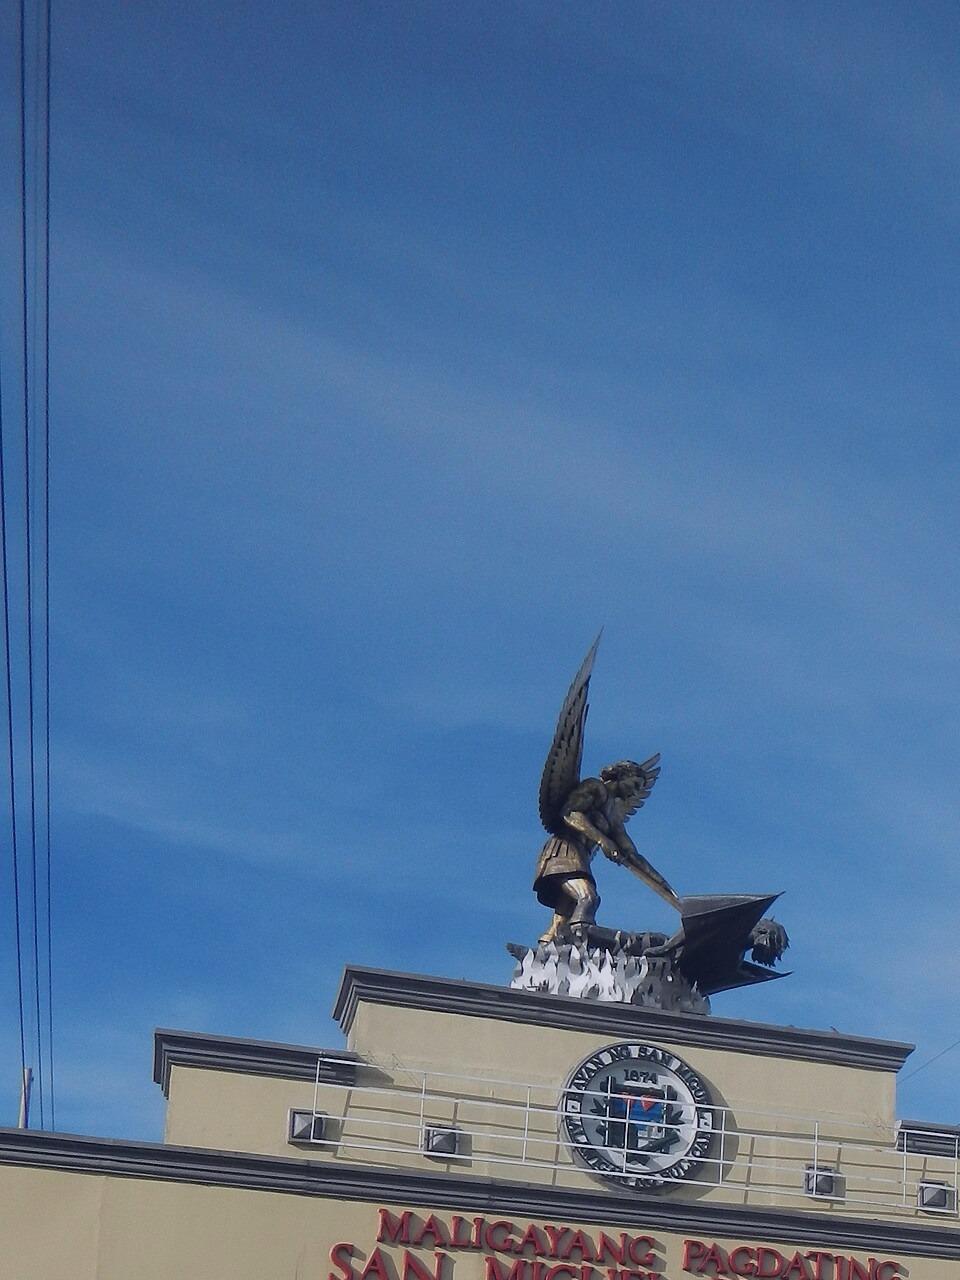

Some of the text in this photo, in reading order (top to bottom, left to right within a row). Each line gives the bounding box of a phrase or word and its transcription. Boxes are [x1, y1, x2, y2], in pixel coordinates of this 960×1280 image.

[639, 1045, 674, 1068] SAN
[623, 1068, 658, 1085] 1874
[376, 1208, 655, 1266] MALIGAYANG
